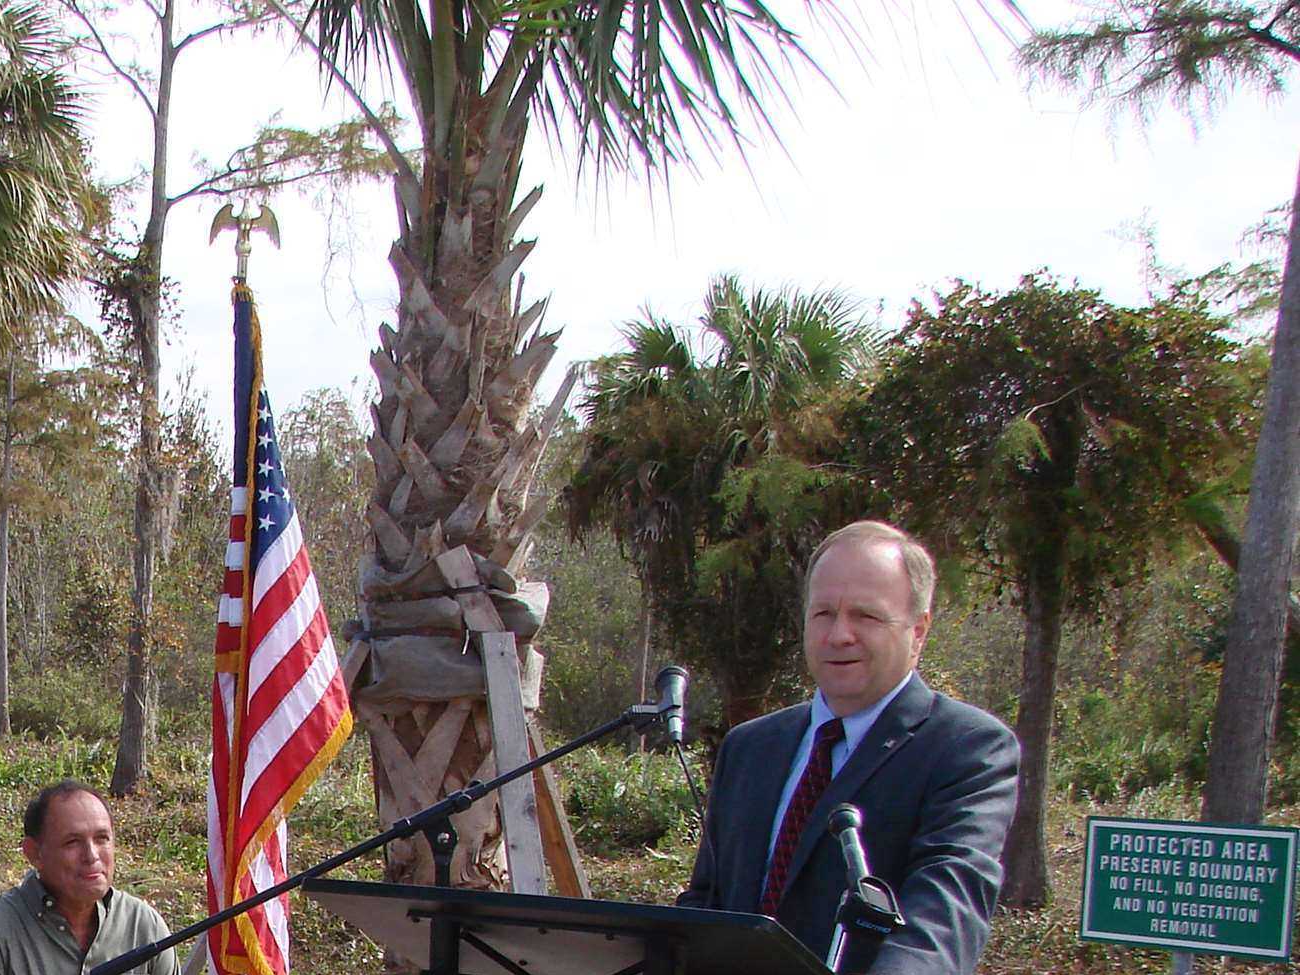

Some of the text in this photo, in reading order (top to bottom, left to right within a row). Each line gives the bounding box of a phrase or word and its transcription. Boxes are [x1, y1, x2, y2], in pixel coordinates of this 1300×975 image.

[1110, 834, 1269, 861] PROTECTED AREA
[1100, 855, 1277, 884] PRESERVE BOUNDARY
[1109, 876, 1264, 903] NO FILL, NO DIGGING,
[1113, 897, 1258, 923] AND NO VEGETATION
[1150, 919, 1216, 938] REMOVAL
